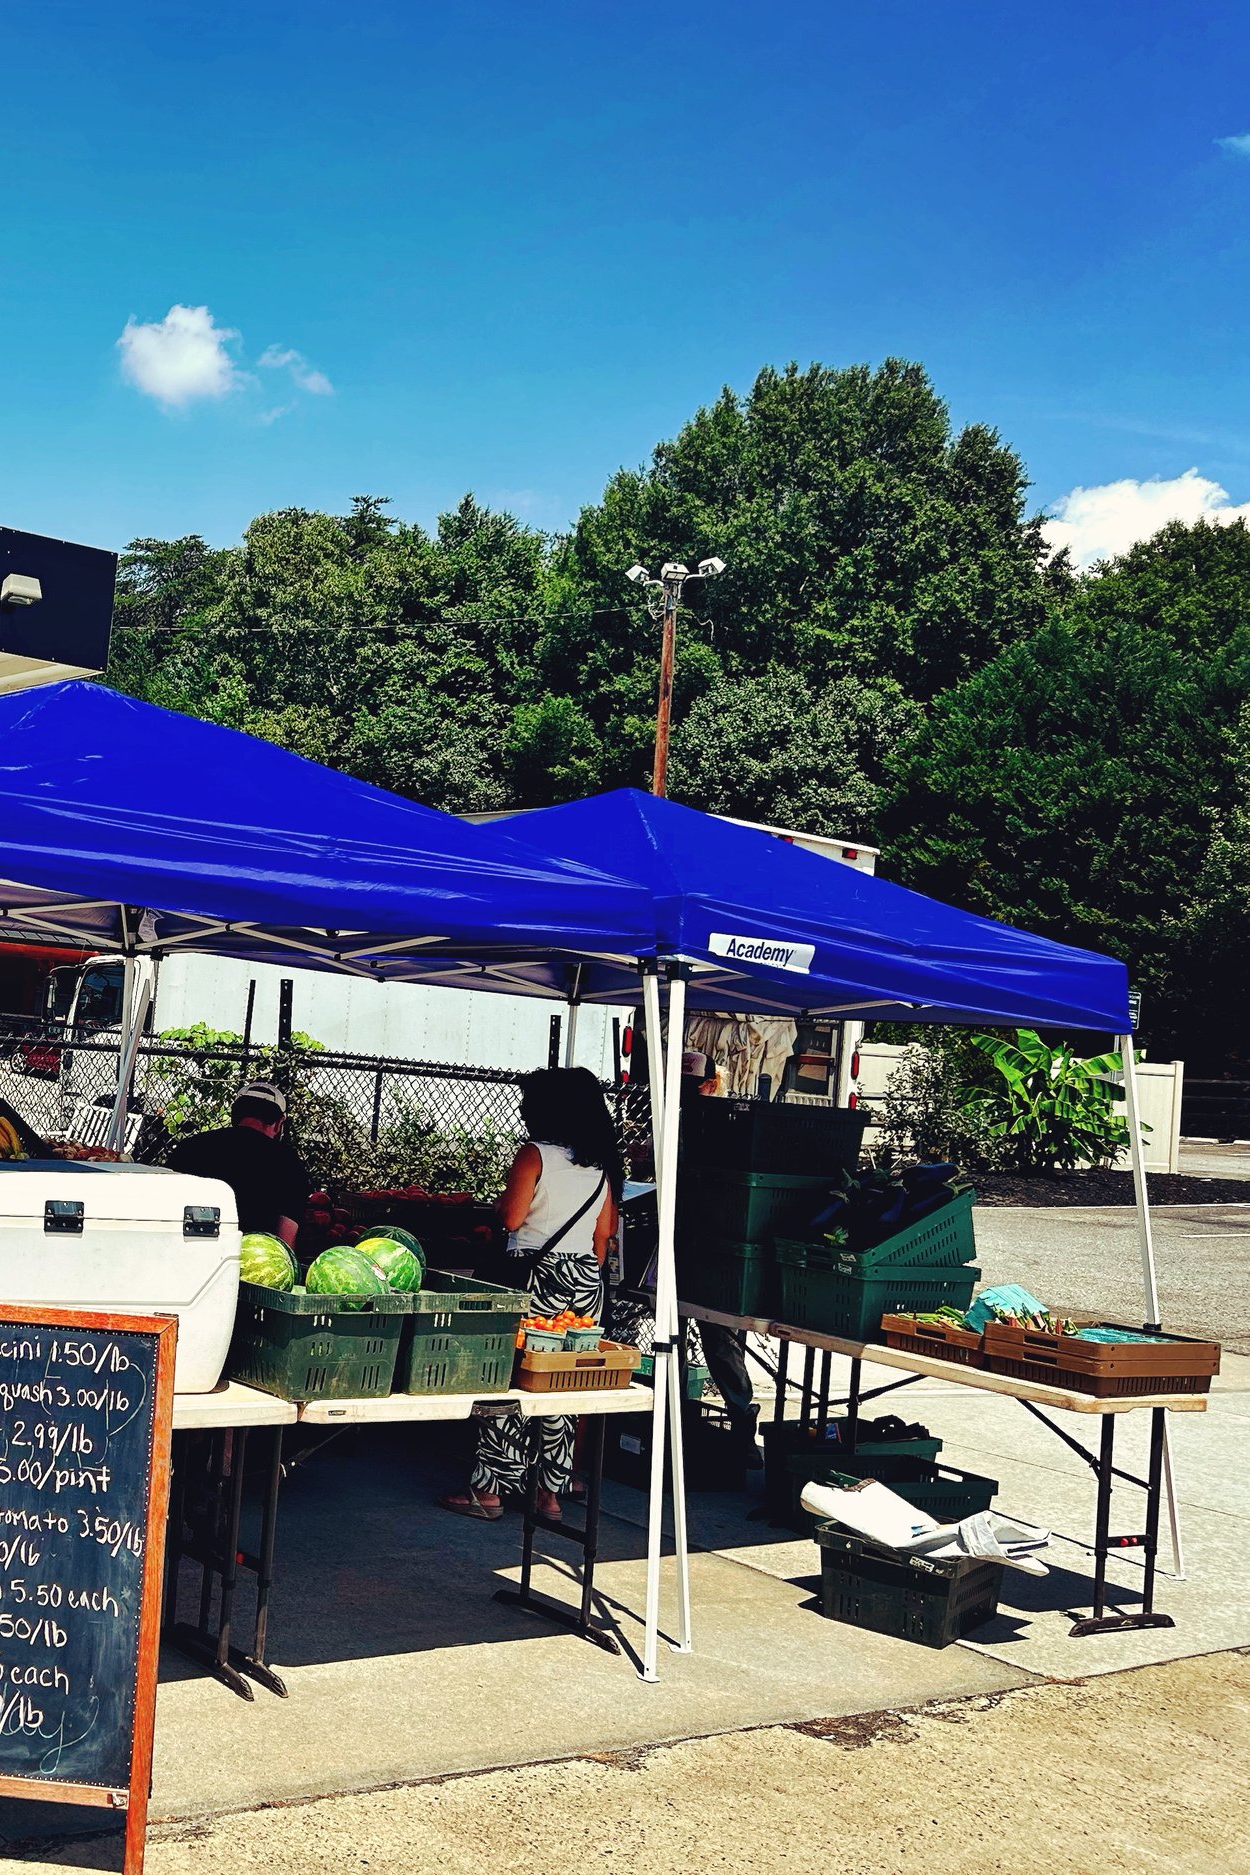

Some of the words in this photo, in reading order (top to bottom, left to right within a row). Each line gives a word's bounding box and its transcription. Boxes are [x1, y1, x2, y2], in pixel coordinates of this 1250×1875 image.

[726, 938, 794, 966] Academy
[51, 1340, 130, 1374] 1.50/lb
[56, 1385, 129, 1411] 3.00/lb
[12, 1421, 93, 1457] 2.99/lb
[10, 1579, 62, 1608] 5.50
[68, 1586, 119, 1617] each
[10, 1664, 69, 1695] each
